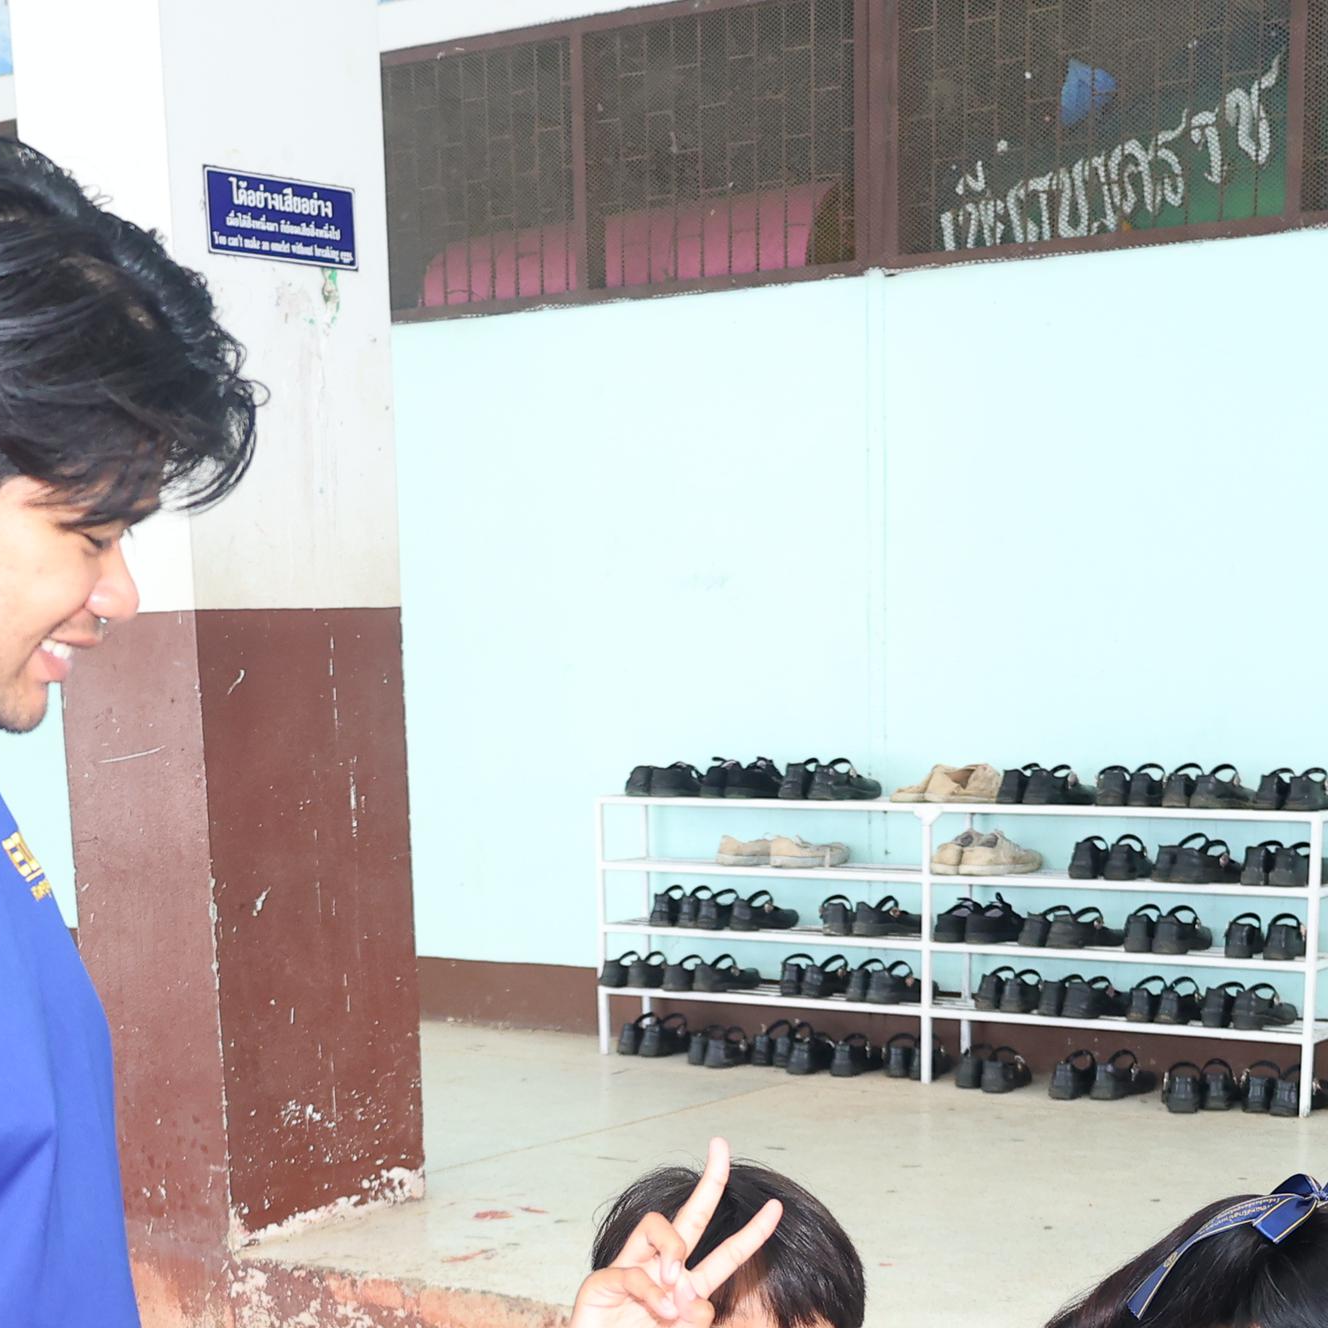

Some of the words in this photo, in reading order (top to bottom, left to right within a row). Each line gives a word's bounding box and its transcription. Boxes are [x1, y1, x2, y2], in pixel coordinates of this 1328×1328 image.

[228, 177, 333, 218] ได้อย่างเสียอย่าง
